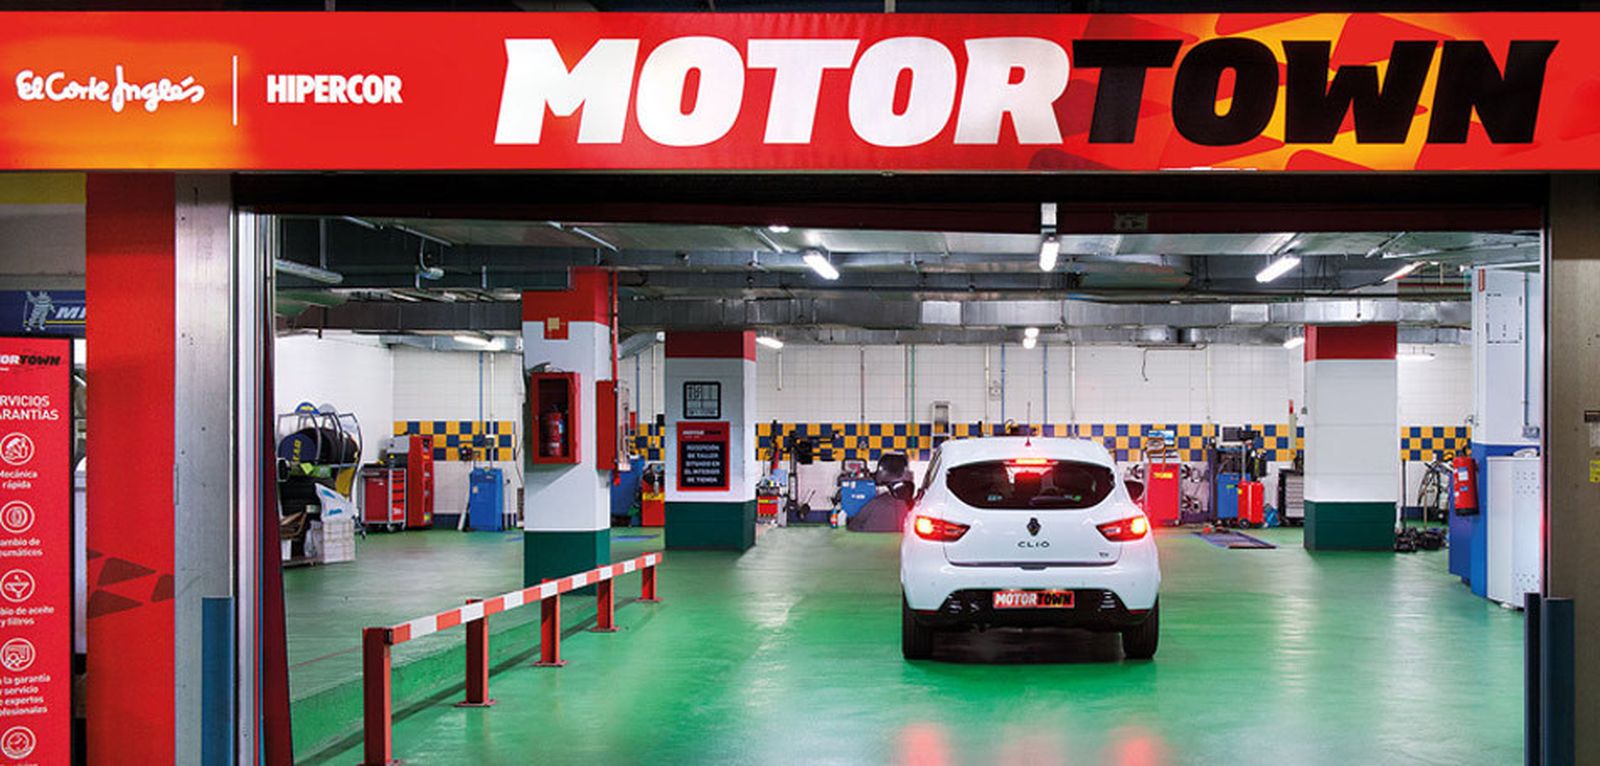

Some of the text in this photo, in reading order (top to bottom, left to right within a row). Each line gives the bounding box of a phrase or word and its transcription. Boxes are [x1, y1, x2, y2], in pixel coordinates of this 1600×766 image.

[16, 65, 205, 112] El Corte Inglés
[267, 75, 402, 103] HIPERCOR
[494, 36, 1559, 146] MOTORTOWN
[0, 406, 60, 421] RANTÍAS
[29, 537, 40, 546] de
[995, 592, 1073, 606] MOTORTOWN
[16, 607, 27, 615] de
[29, 606, 55, 615] aceite
[8, 617, 35, 626] filtros
[4, 686, 39, 696] servicio
